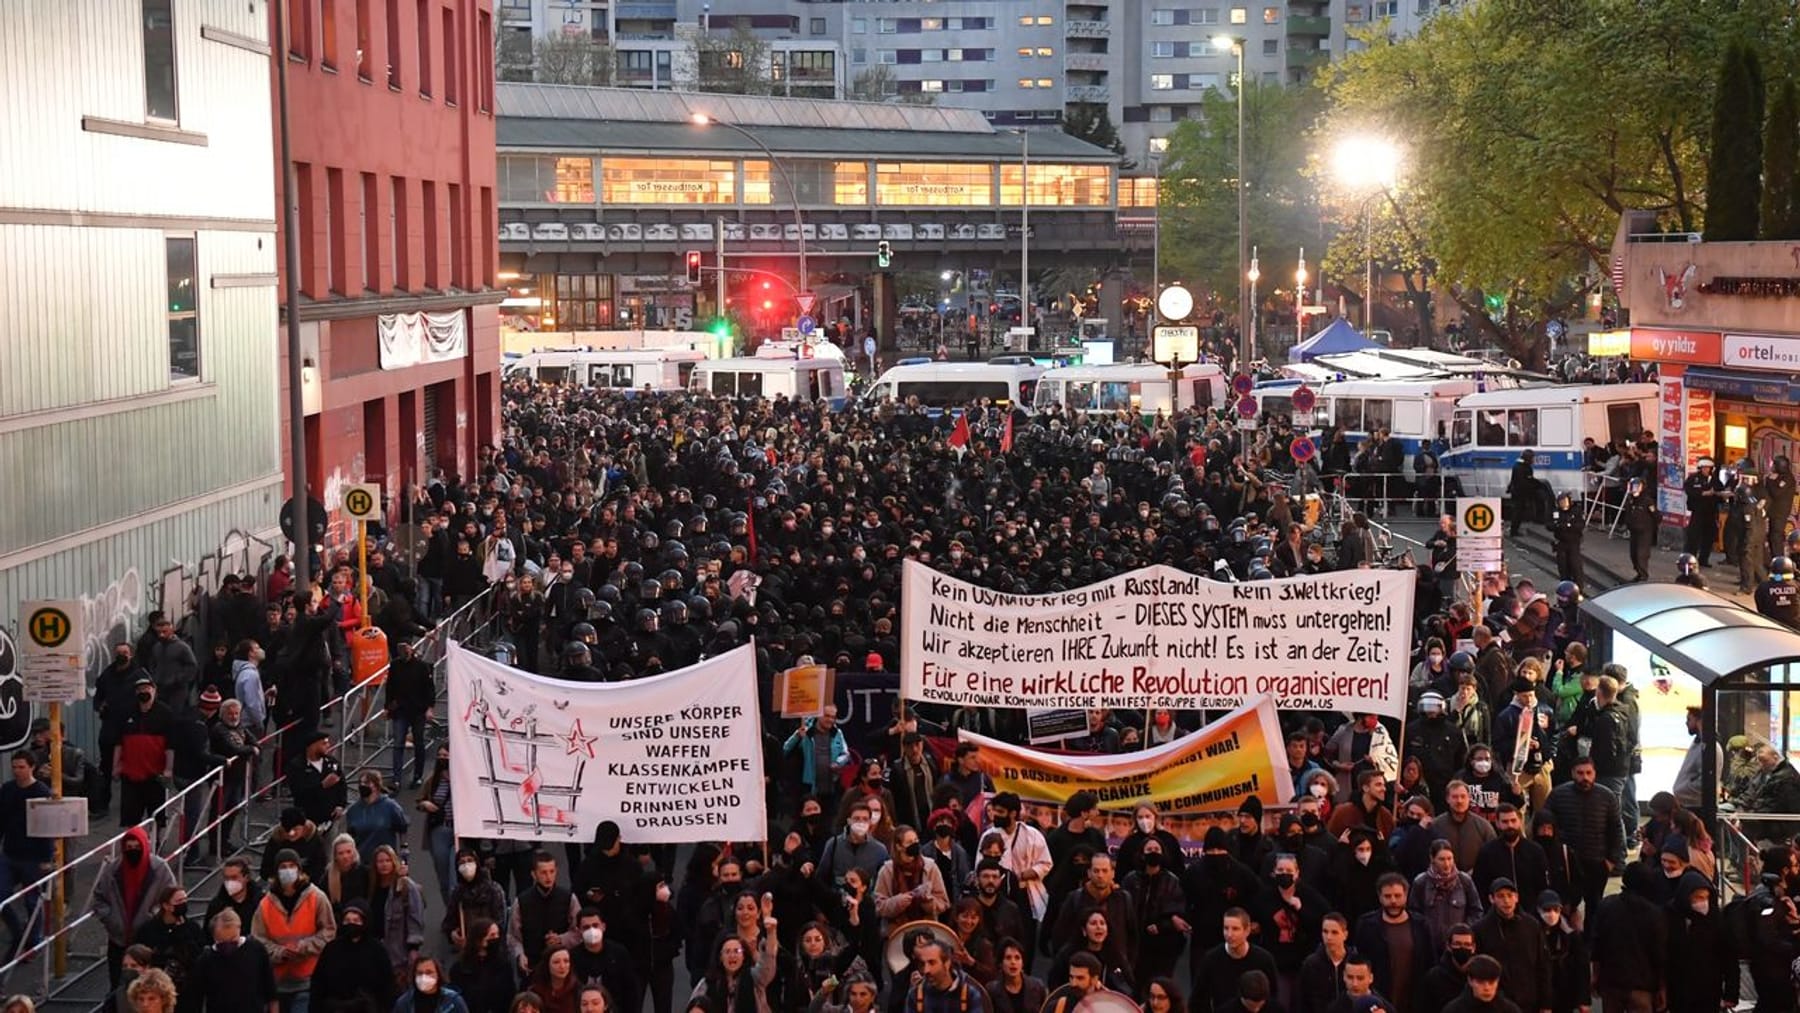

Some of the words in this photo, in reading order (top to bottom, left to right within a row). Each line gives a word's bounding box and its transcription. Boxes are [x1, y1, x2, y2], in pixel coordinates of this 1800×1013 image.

[1739, 344, 1774, 360] ortel
[932, 576, 967, 602] Kein
[1091, 584, 1116, 603] mit
[1125, 576, 1200, 596] Russland!
[1234, 585, 1271, 600] Kein
[930, 603, 975, 631] Nicht
[983, 616, 1010, 633] die
[1016, 612, 1102, 634] Menschheit
[1135, 602, 1187, 627] DIESES
[1192, 603, 1249, 629] SYSTEM
[1253, 613, 1287, 630] muss
[1296, 605, 1391, 635] untergehen!
[922, 630, 951, 654] Wir
[958, 640, 1054, 664] akzeptieren
[1062, 636, 1097, 661] IHRE
[1101, 633, 1159, 659] Zukunft
[1167, 635, 1217, 659] nicht!
[1226, 635, 1245, 660] Es
[1255, 637, 1278, 660] ist
[1286, 644, 1307, 660] an
[1312, 638, 1341, 660] der
[1346, 636, 1389, 664] Zeit:
[923, 661, 957, 689] Für
[967, 671, 1014, 694] eine
[1021, 668, 1125, 696] wirkliche
[1132, 666, 1247, 696] Revolution
[1256, 671, 1389, 701] organisieren!
[1004, 695, 1096, 708] KOMMUNISTISCHE
[1101, 696, 1196, 708] MANIFEST-GRUPPE
[1275, 698, 1334, 709] VCOM.US
[609, 713, 675, 729] UNSERE
[680, 703, 743, 721] KÖRPER
[621, 727, 664, 741] SIND
[670, 726, 730, 740] UNSERE
[645, 744, 711, 759] WAFFEN
[1205, 730, 1241, 759] WAR!
[608, 759, 750, 777] KLASSENKÄMPFE
[625, 777, 734, 796] ENTWICKELN
[1174, 772, 1259, 809] COMMUNISM!
[620, 799, 697, 814] DRINNEN
[703, 795, 741, 809] UND
[636, 812, 728, 828] DRAUSSEN
